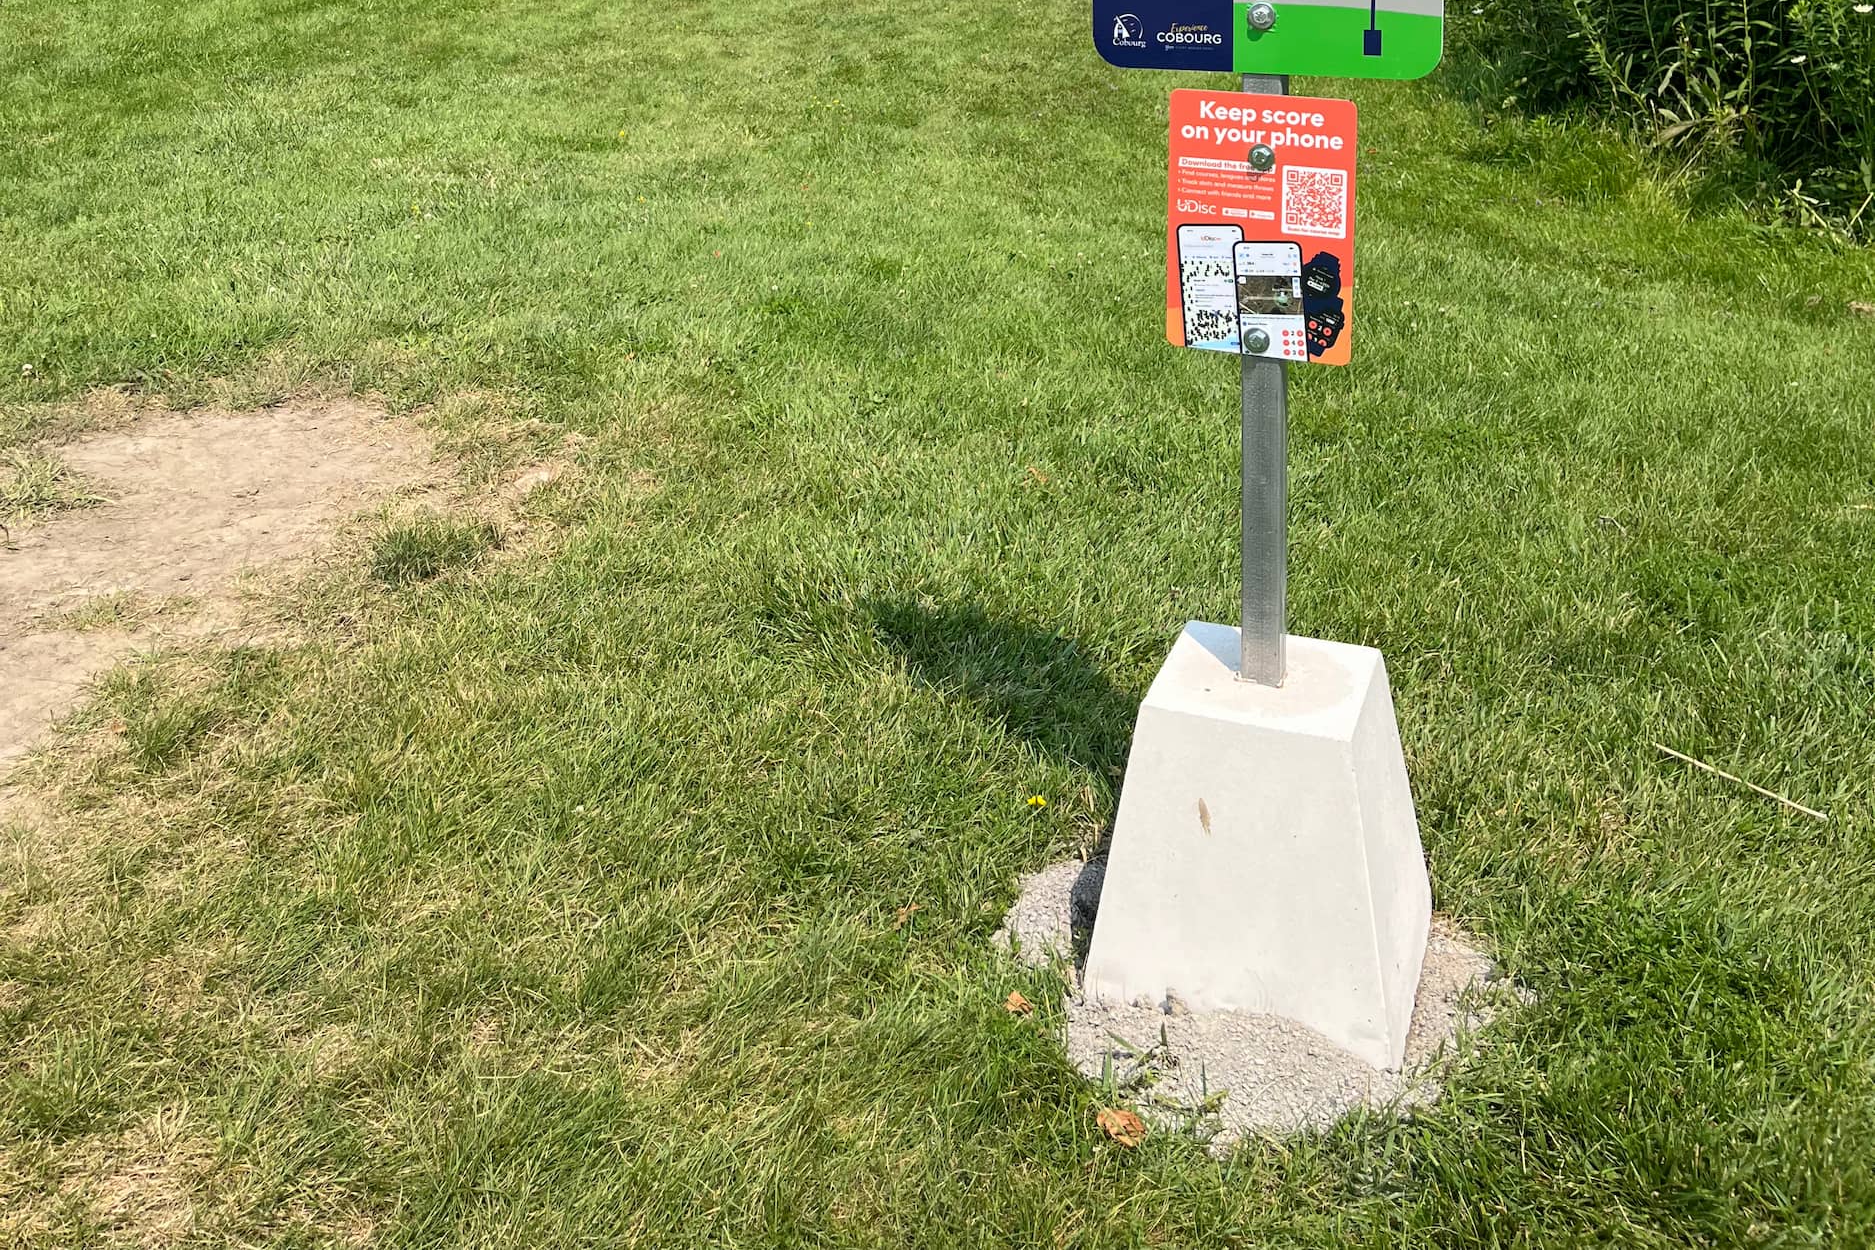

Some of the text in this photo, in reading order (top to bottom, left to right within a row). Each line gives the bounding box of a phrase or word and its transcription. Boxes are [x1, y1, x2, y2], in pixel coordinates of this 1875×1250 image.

[1112, 37, 1147, 48] Cobourg
[1156, 32, 1222, 45] COBOURG
[1199, 100, 1325, 128] Keep score
[1181, 124, 1344, 150] on your phone
[1181, 157, 1222, 169] Download
[1224, 161, 1237, 169] the
[1176, 197, 1217, 215] UDisc
